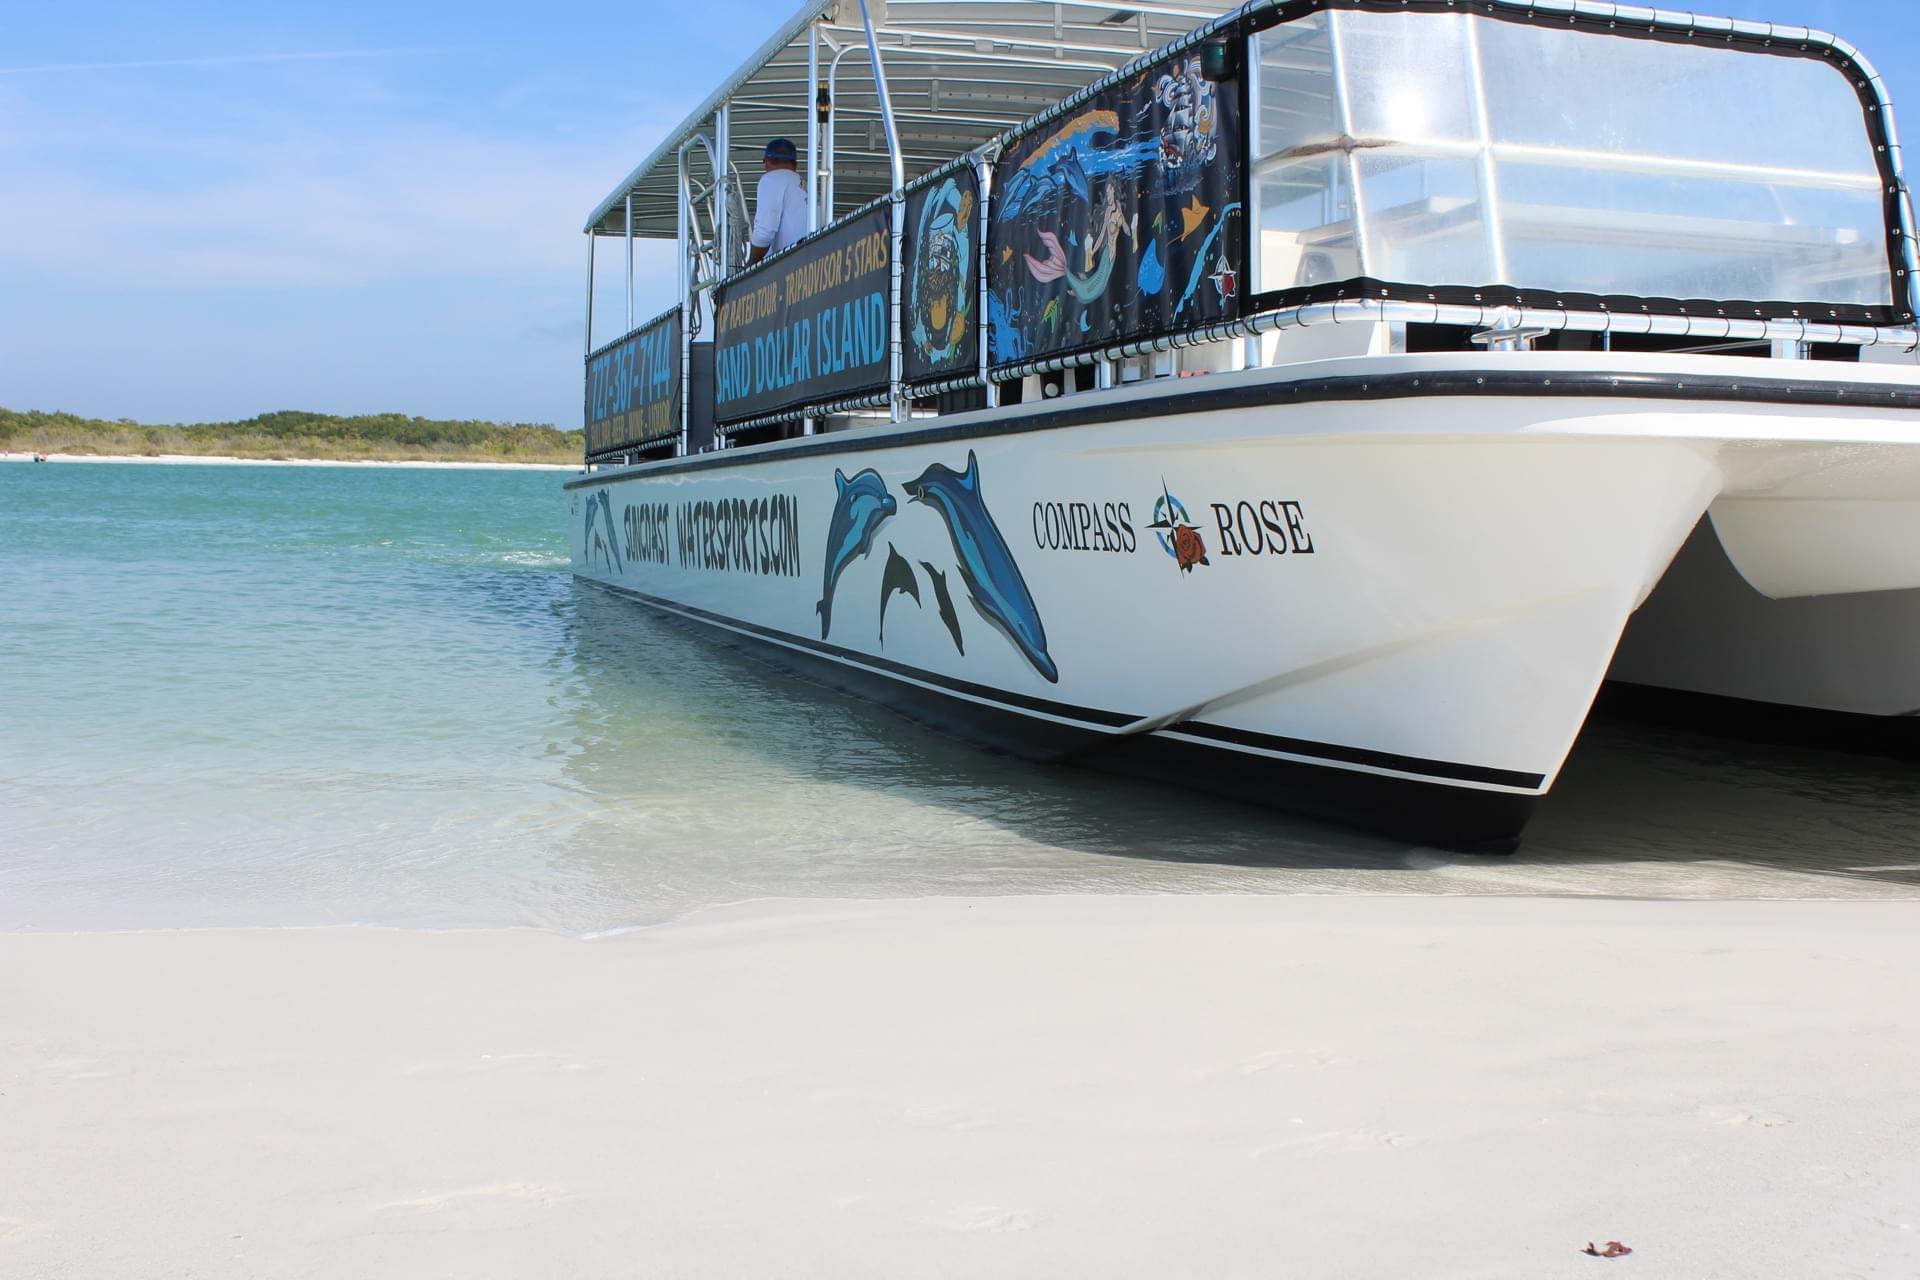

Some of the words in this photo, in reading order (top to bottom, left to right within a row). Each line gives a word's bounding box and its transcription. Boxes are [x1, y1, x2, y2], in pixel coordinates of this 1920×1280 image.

[730, 292, 756, 329] RATED
[757, 281, 777, 321] TOUR
[785, 250, 842, 306] TRIPADVISOR
[845, 248, 851, 283] 5
[854, 228, 888, 277] STARS
[592, 321, 671, 422] 727-367-7144
[716, 342, 751, 404] SAND
[756, 318, 811, 394] DOLLAR
[817, 292, 886, 377] ISLAND
[624, 502, 669, 567] SUNCOAST
[676, 493, 800, 578] WATERSPORTS.COM
[1033, 501, 1136, 553] COMPASS
[1211, 500, 1315, 556] ROSE
